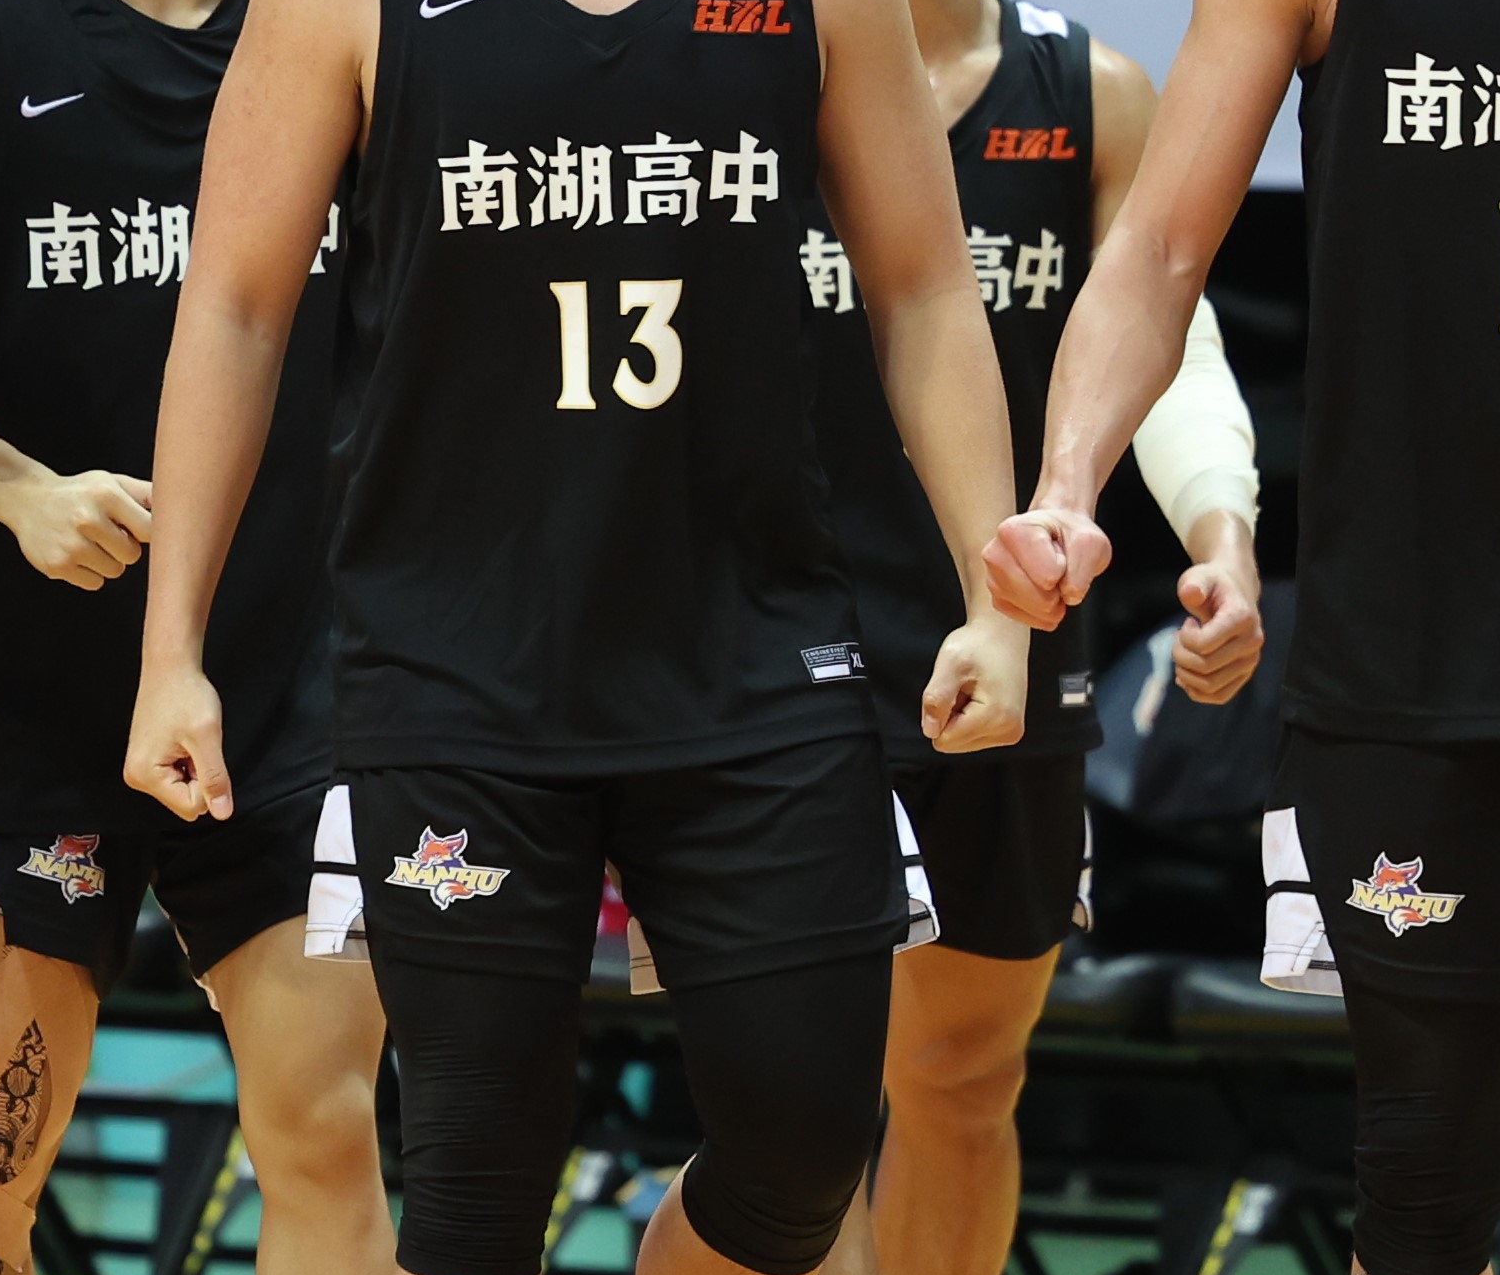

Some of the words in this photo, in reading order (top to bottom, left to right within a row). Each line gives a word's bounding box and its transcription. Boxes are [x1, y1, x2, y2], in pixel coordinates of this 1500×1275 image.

[983, 128, 1076, 161] HBL
[438, 131, 780, 232] 南湖高中
[26, 197, 340, 291] 南湖
[799, 225, 1064, 313] 南高中
[549, 278, 683, 411] 13
[851, 652, 865, 668] XL
[25, 851, 105, 891] NANH
[395, 860, 506, 896] NANHU
[1352, 885, 1460, 918] NANHU
